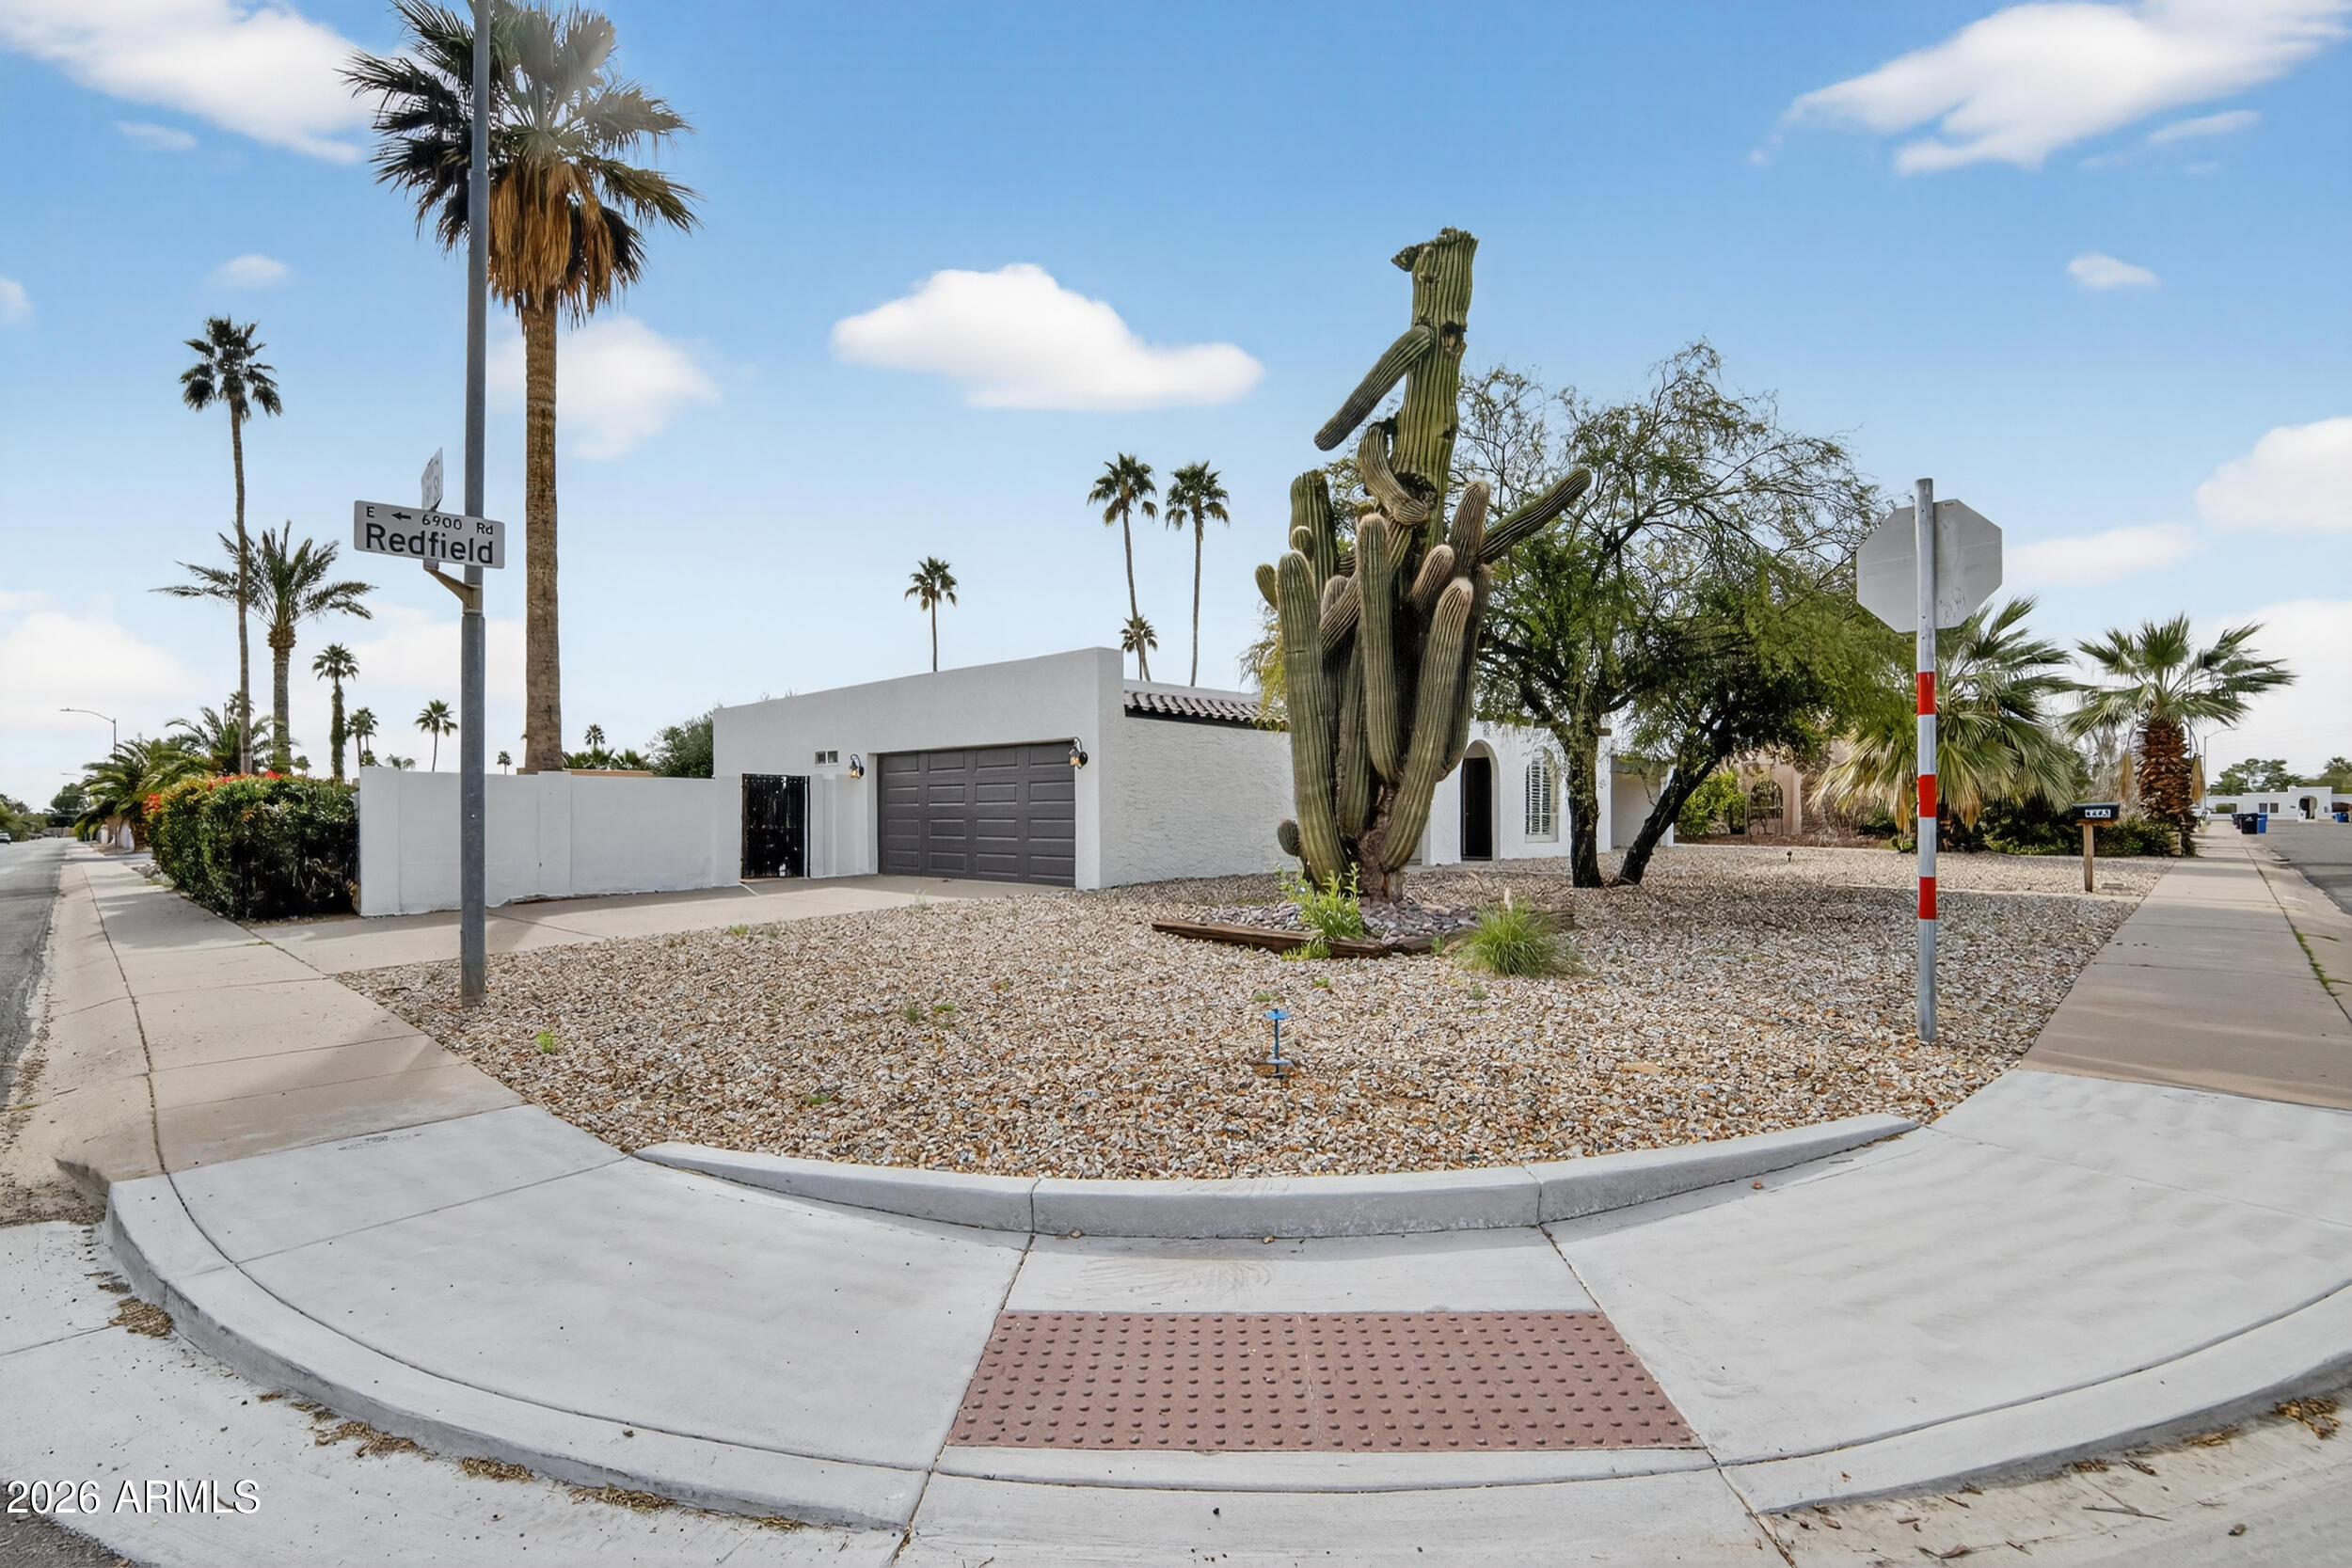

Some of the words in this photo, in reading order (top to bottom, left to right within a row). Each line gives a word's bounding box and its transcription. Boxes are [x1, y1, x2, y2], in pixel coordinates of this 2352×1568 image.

[366, 506, 375, 517] E
[421, 515, 462, 530] 6900
[476, 522, 494, 535] Rd
[366, 523, 493, 564] Redfield
